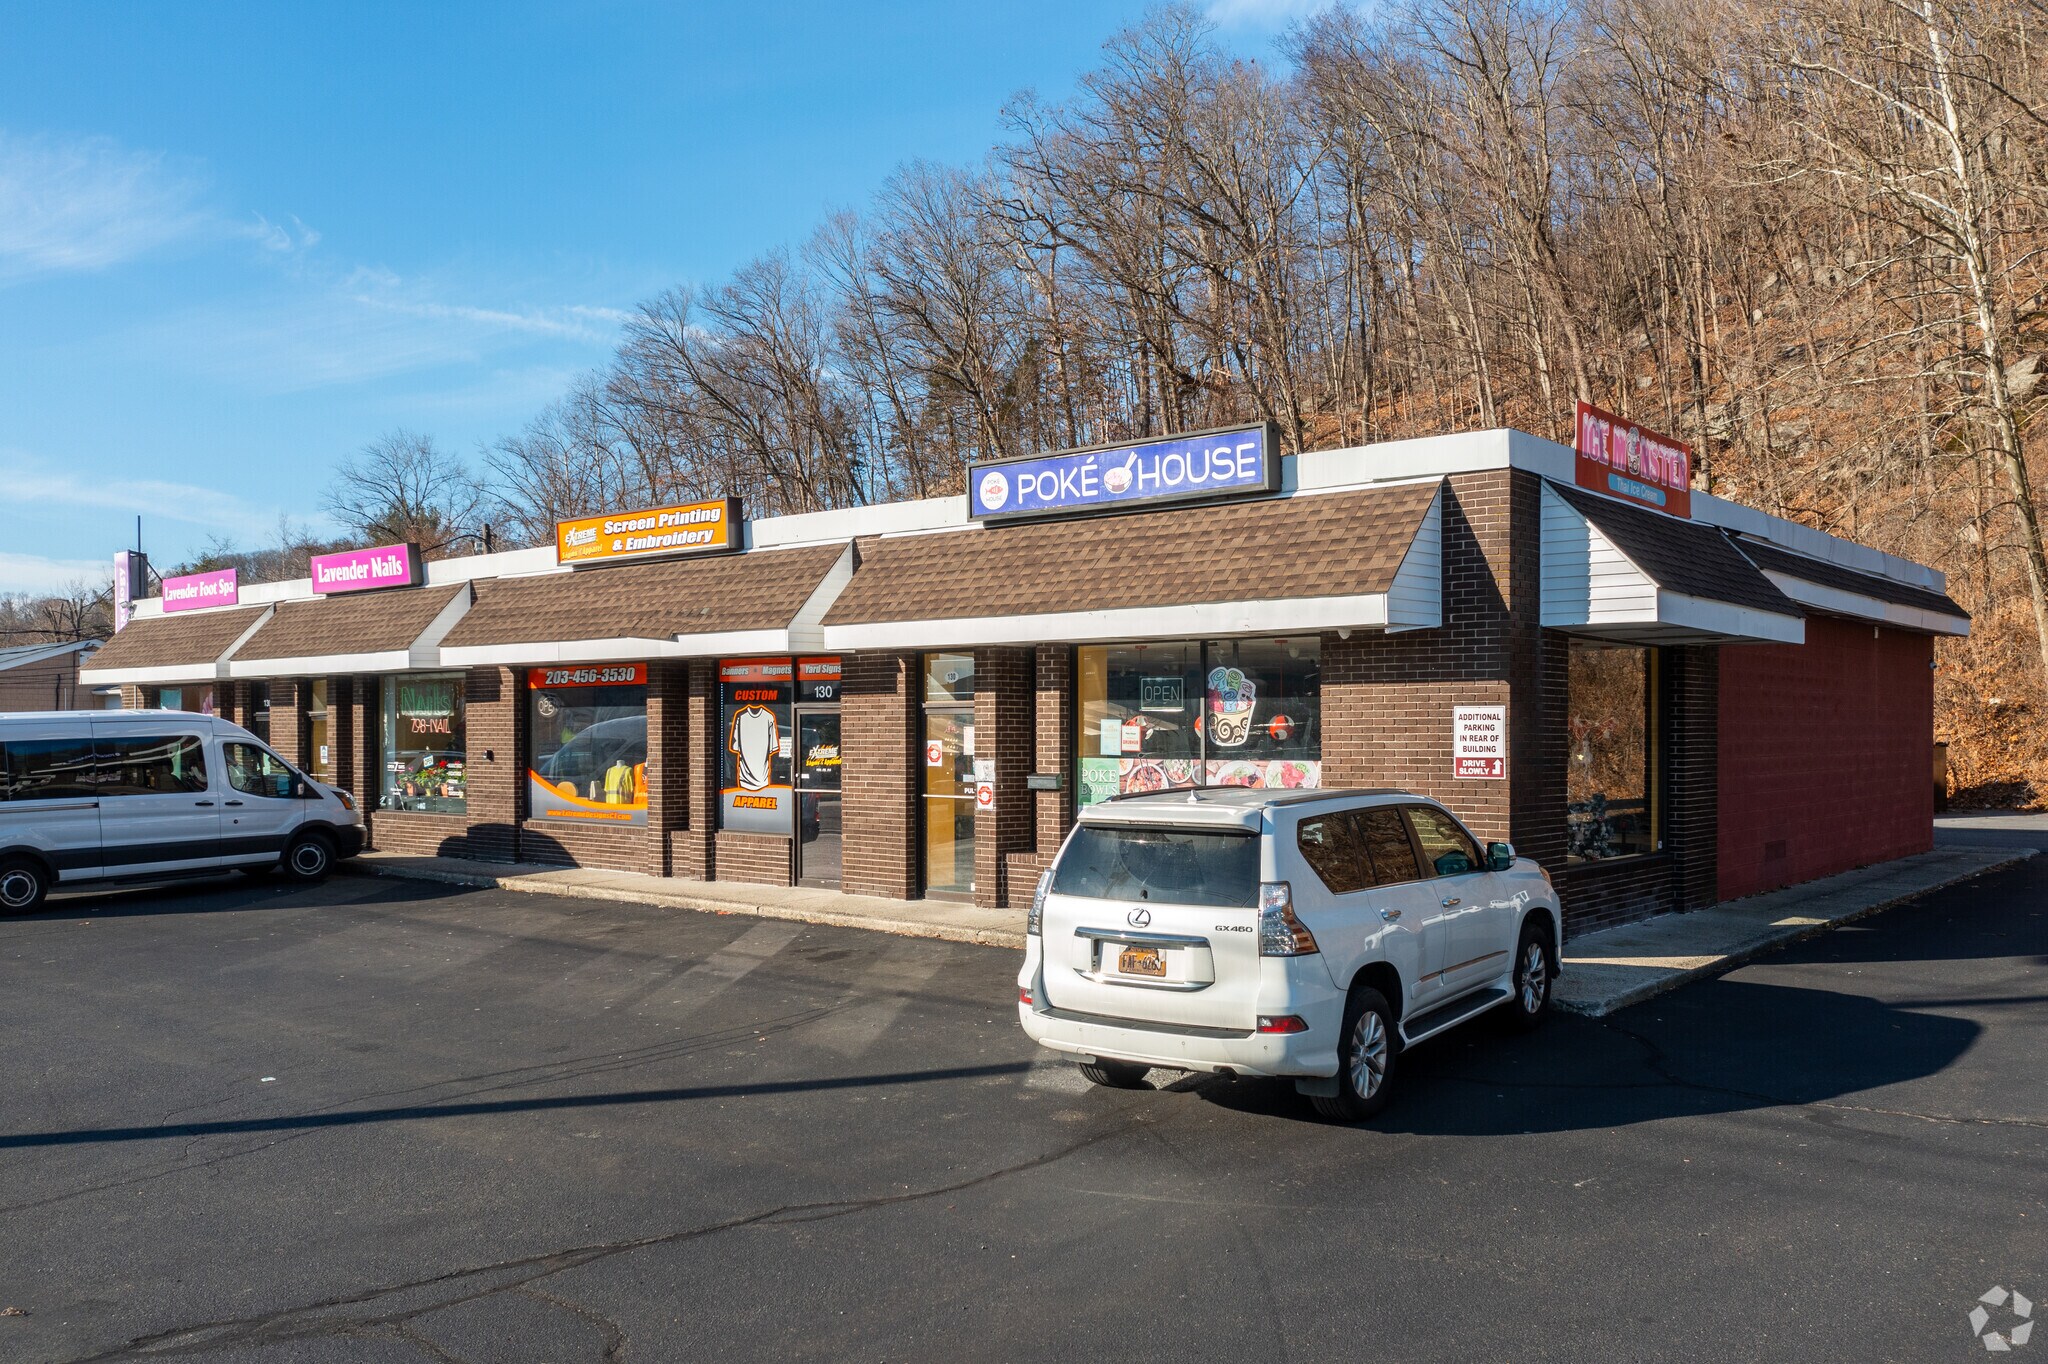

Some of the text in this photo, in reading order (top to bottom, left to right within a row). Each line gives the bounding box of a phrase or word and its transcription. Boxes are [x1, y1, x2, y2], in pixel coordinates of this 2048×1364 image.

[1582, 412, 1609, 465] ICE
[1017, 442, 1256, 504] POKÉ HOUSE
[1617, 477, 1659, 501] Thai Ice Cream
[604, 507, 722, 535] Screen Printing
[612, 538, 624, 552] &
[625, 528, 715, 552] Embroidery
[317, 555, 403, 584] Lavender Nails
[164, 578, 235, 602] Lavender Foot Spa
[545, 667, 635, 685] 203-456-3530
[762, 665, 792, 676] Magnets
[805, 664, 821, 674] Yard
[821, 663, 842, 675] Signs
[947, 673, 957, 681] 130
[401, 685, 452, 716] Nails
[734, 690, 779, 701] CUSTOM
[814, 685, 833, 699] 130
[1144, 685, 1180, 701] OPEN
[1082, 770, 1117, 783] POKE
[1080, 785, 1117, 795] BOWLS
[733, 795, 778, 809] APPAREL
[1215, 925, 1253, 933] GX460
